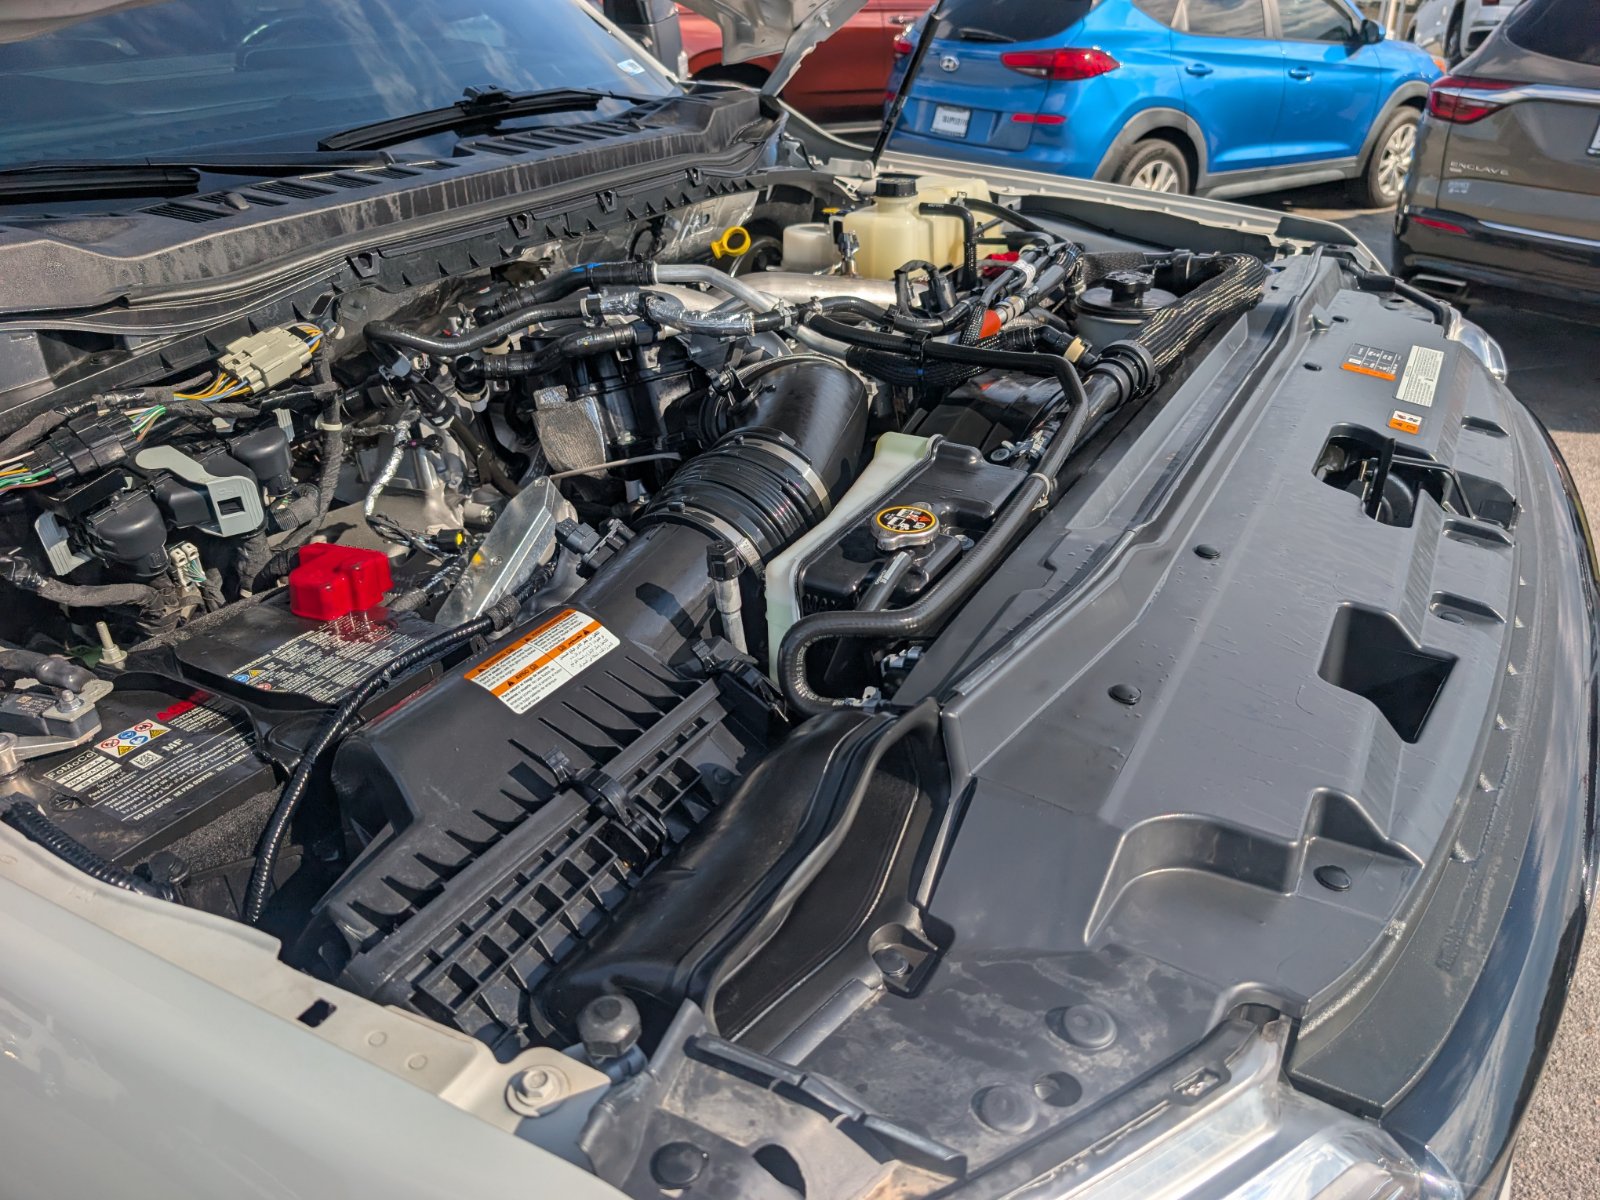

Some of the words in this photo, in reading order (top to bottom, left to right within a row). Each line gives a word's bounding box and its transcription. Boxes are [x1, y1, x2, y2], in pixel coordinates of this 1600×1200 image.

[1450, 160, 1509, 176] ENCLAVE
[514, 670, 529, 679] AVISO
[162, 738, 183, 751] MF
[47, 752, 95, 778] FoMoCo
[142, 806, 155, 815] NOT
